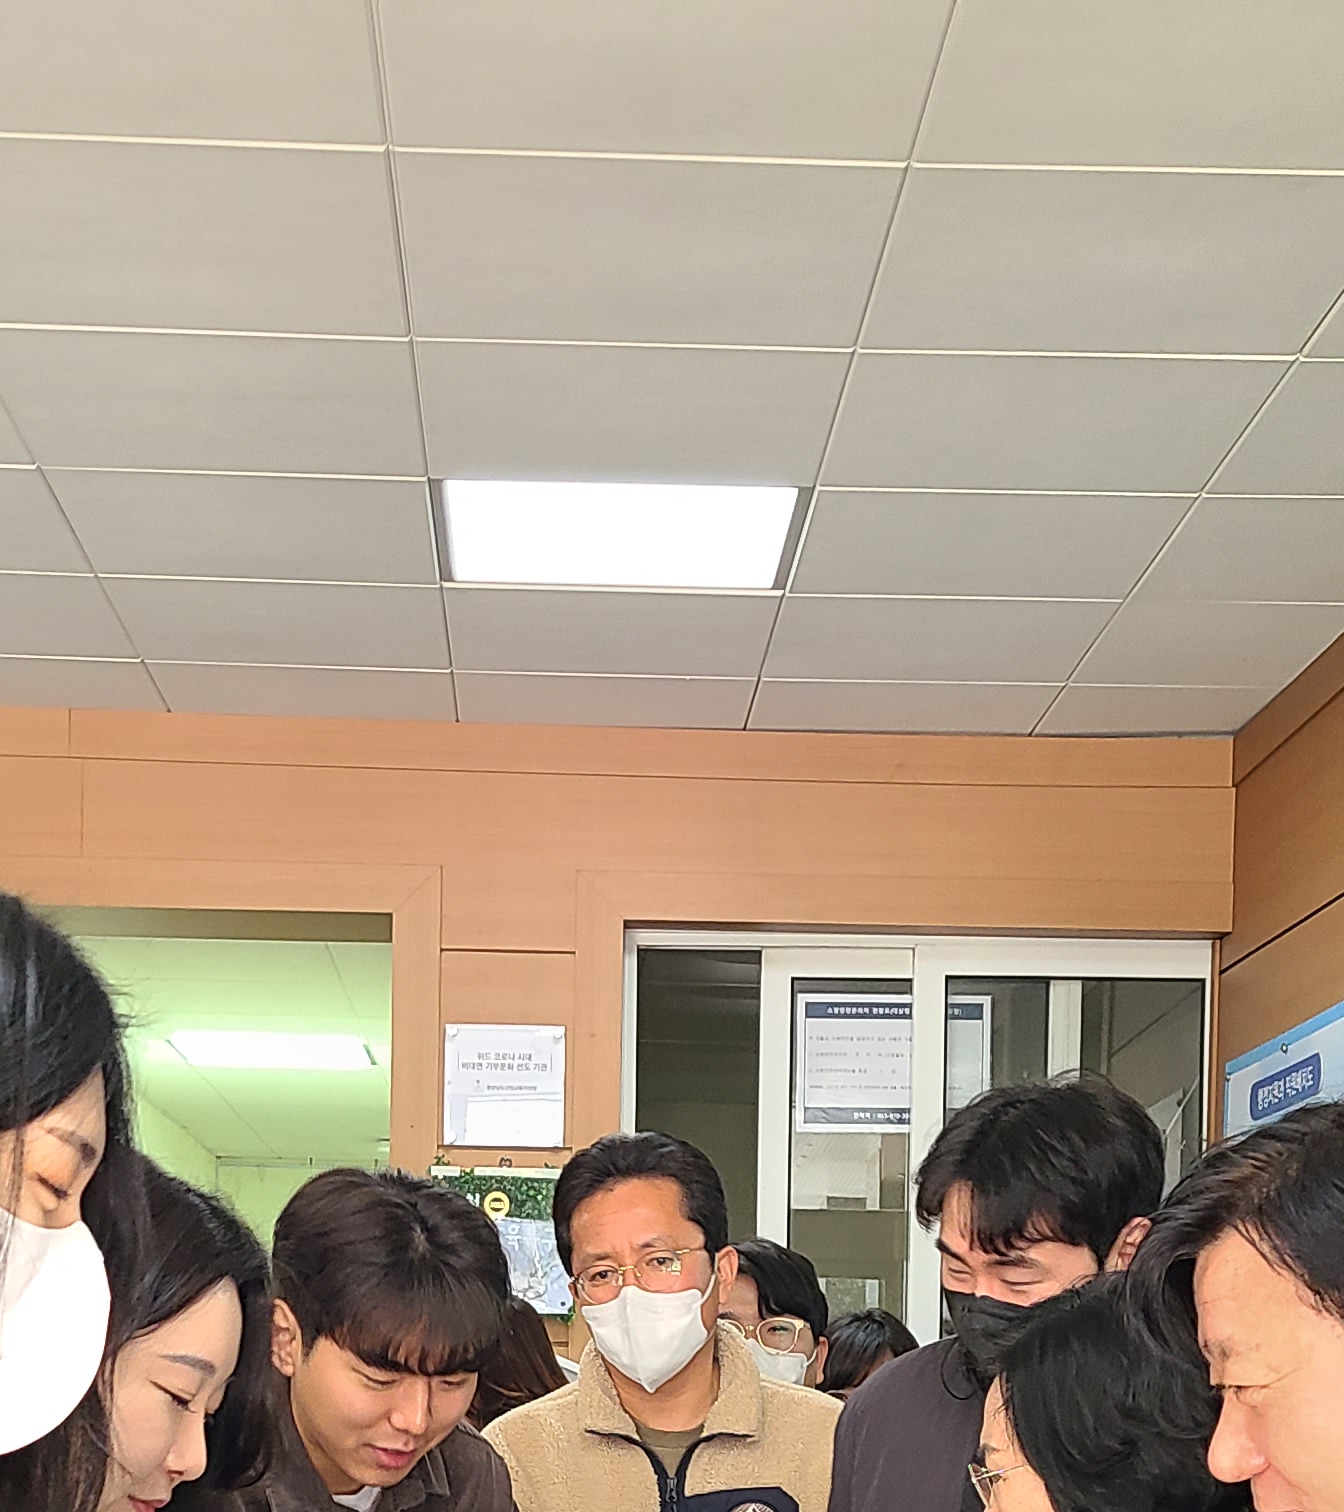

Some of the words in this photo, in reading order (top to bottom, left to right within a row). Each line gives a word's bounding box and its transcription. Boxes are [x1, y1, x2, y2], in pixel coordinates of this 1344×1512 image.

[518, 1053, 532, 1061] 시대
[462, 1062, 483, 1071] 비대면
[485, 1062, 514, 1071] 기부문화
[517, 1063, 531, 1071] 선도
[533, 1063, 548, 1071] 기관
